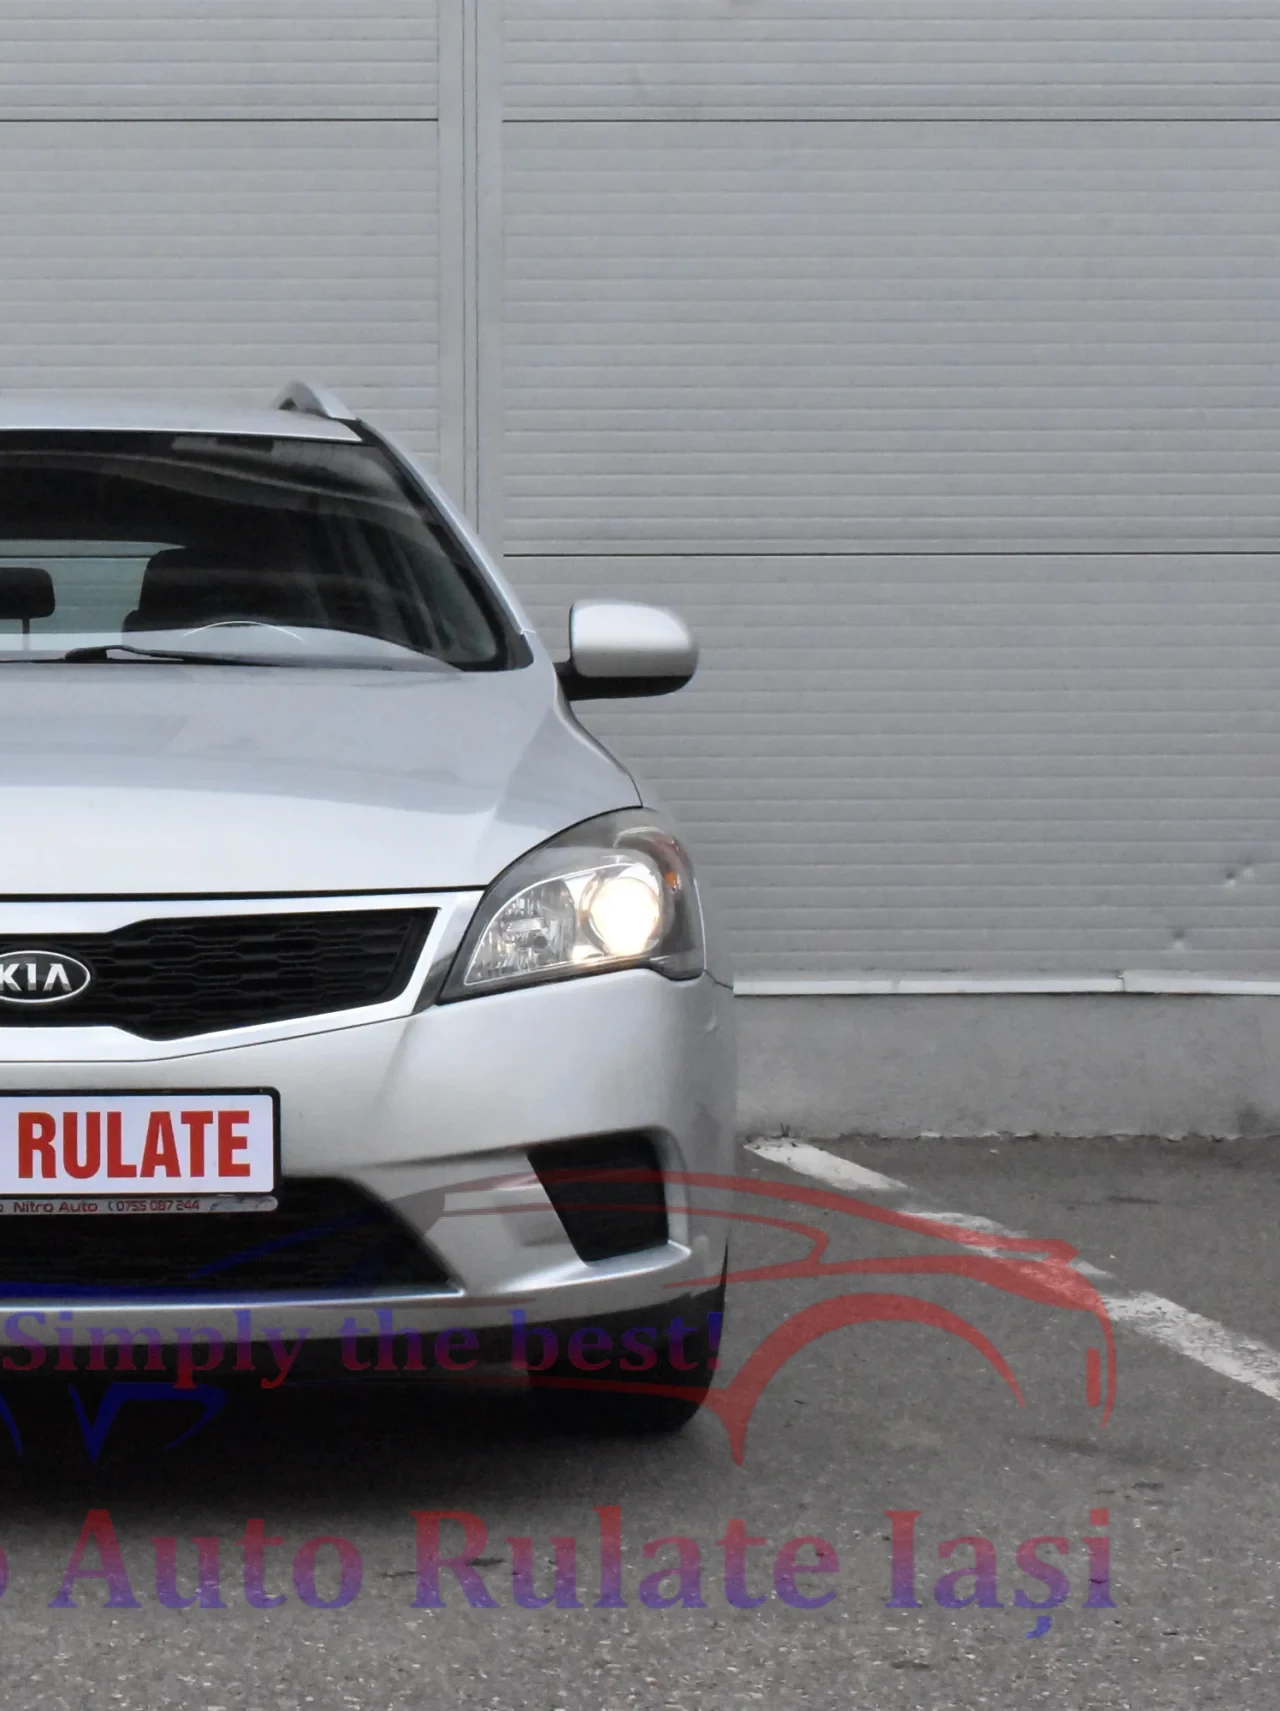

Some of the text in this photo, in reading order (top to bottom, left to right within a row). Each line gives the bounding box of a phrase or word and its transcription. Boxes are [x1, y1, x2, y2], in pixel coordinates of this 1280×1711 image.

[18, 1110, 251, 1179] RULATE
[13, 1202, 54, 1214] Nitro
[58, 1202, 98, 1213] Auto
[116, 1201, 147, 1212] 0755
[176, 1200, 200, 1211] 244
